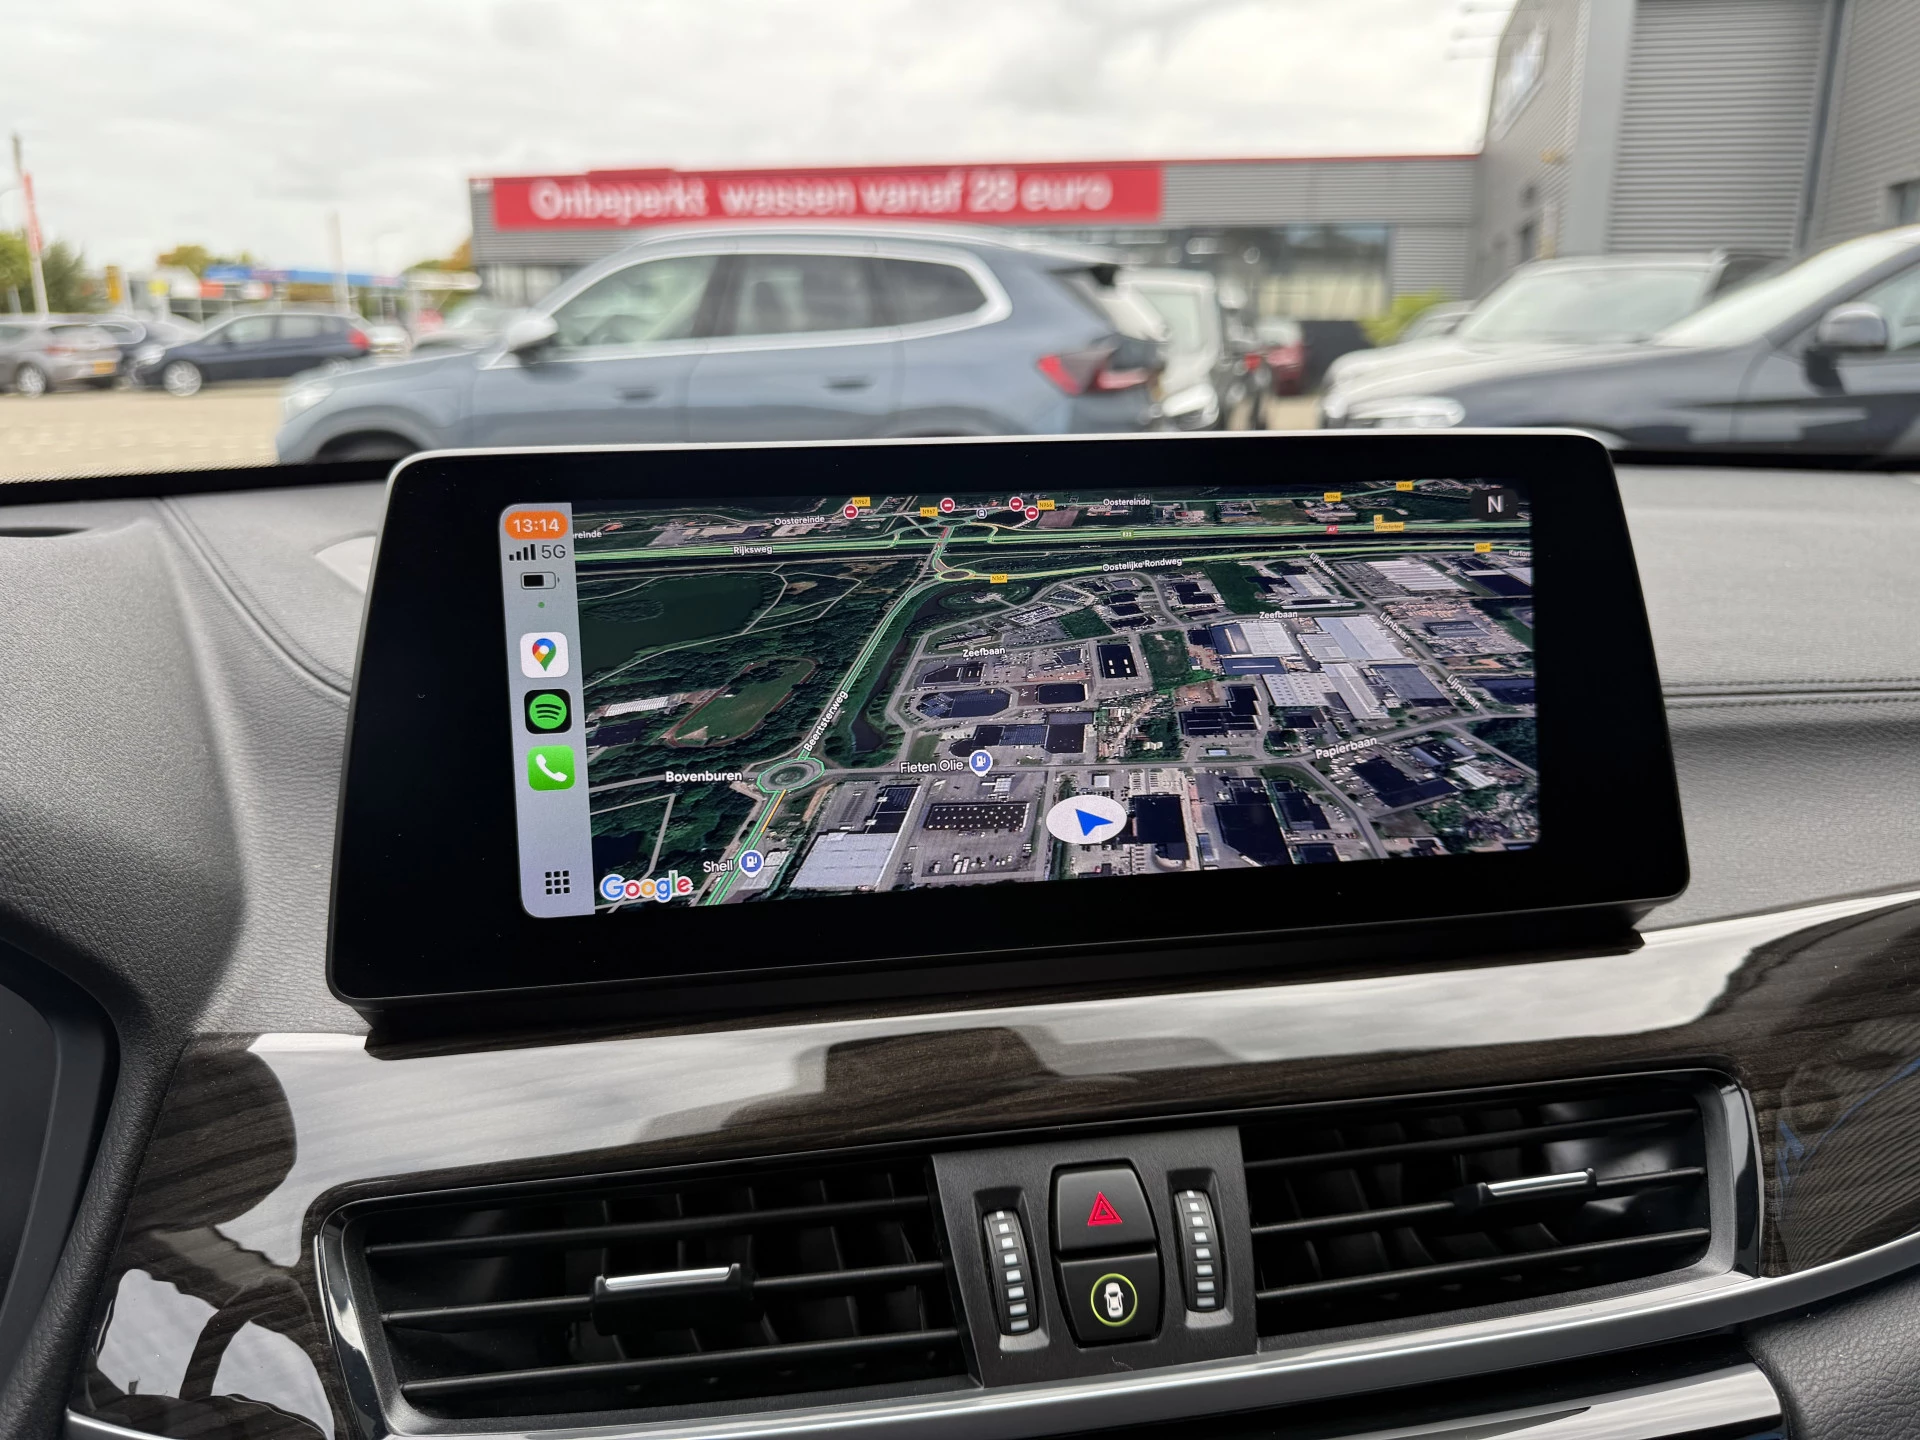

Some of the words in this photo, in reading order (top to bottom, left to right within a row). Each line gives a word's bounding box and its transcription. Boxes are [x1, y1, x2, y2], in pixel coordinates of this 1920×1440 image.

[717, 176, 855, 218] wassen
[858, 168, 967, 214] vanaf
[1020, 173, 1114, 212] euro
[1103, 498, 1150, 506] Oostereinde
[1487, 495, 1504, 513] N
[513, 518, 560, 533] 13:14
[774, 515, 825, 526] Oostereinde
[541, 544, 566, 559] 5G
[733, 546, 773, 556] Rijksweg
[1102, 560, 1144, 572] Oostelijke
[1144, 557, 1183, 568] Rondweg
[1308, 551, 1336, 578] Lijnbaan
[1259, 610, 1298, 620] Zeefbaan
[1378, 611, 1411, 643] Lijnbaan
[962, 646, 1006, 659] Zeefbaan
[1446, 674, 1481, 710] Lijnbaan
[803, 690, 848, 752] Beertsterweg
[1315, 735, 1378, 760] Papierbaan
[900, 761, 937, 774] Fieten
[939, 759, 965, 772] Olie
[665, 770, 743, 784] Bovenburen
[703, 859, 734, 874] Shell
[600, 870, 695, 903] Google
